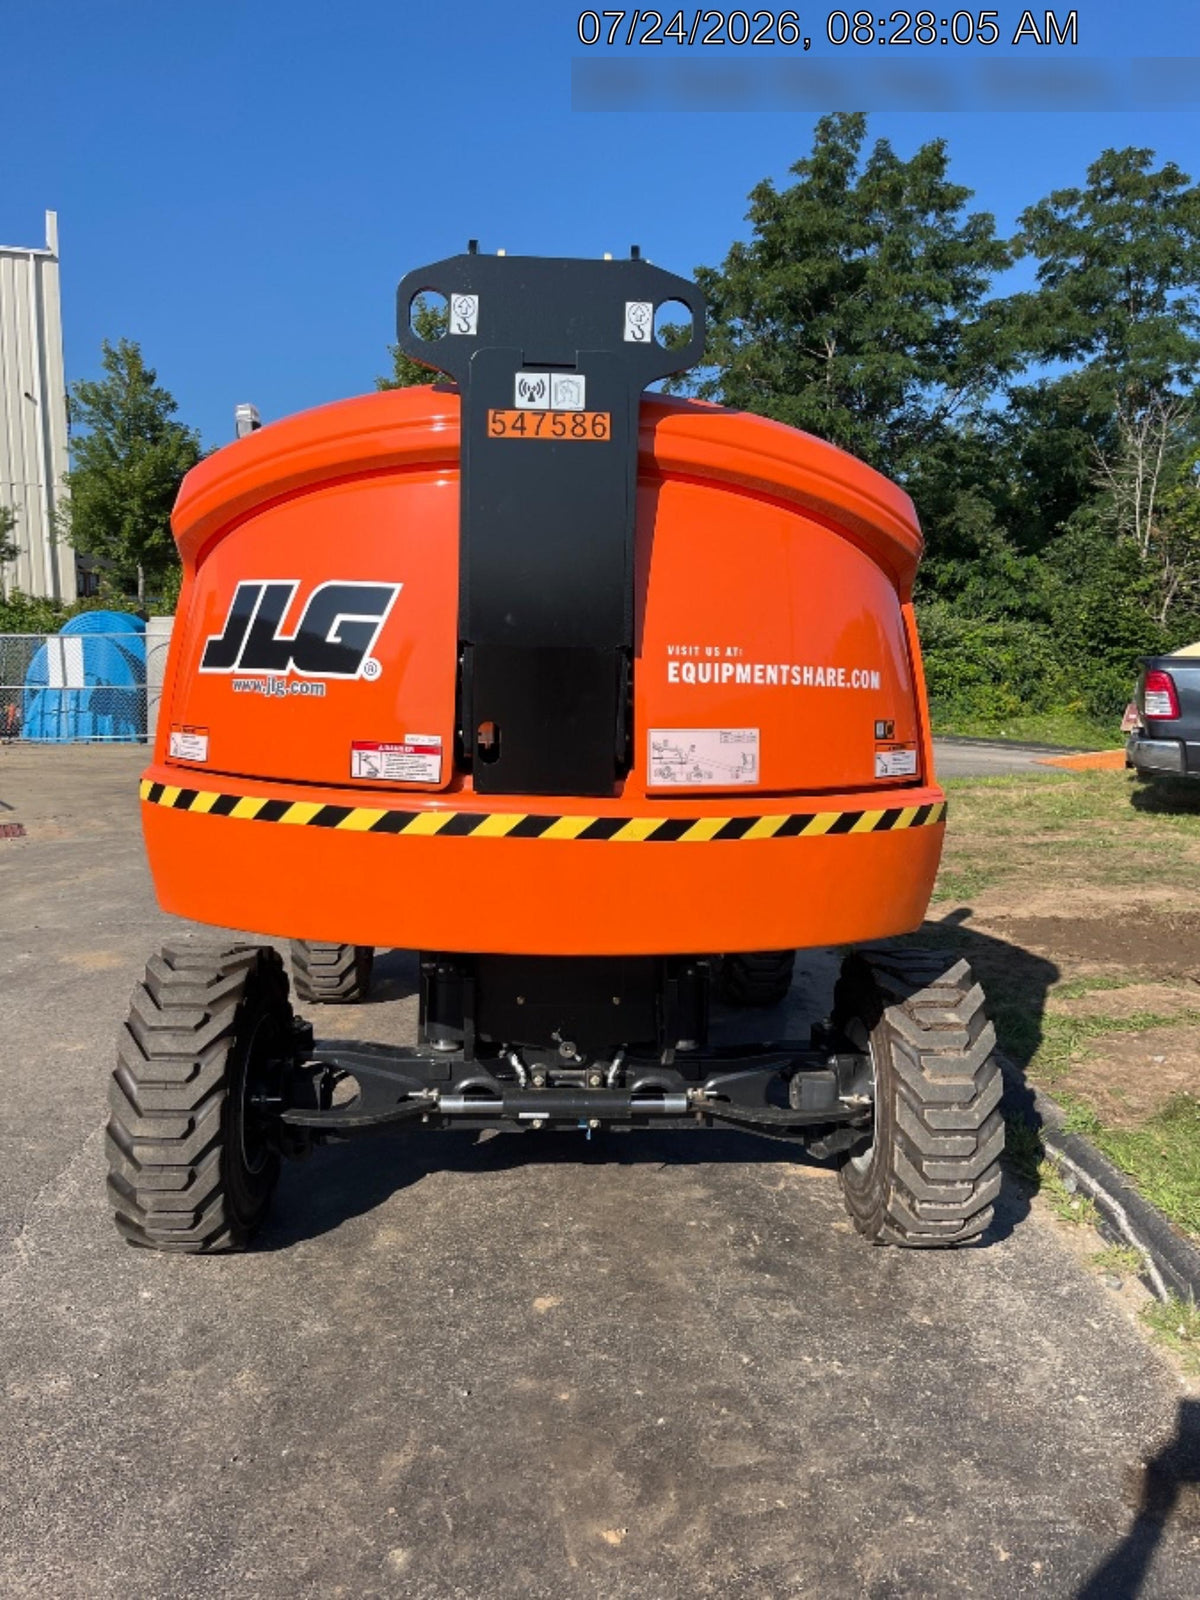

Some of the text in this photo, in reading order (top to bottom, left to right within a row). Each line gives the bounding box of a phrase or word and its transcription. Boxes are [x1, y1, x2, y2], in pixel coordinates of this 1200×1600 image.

[491, 411, 607, 438] 547586
[667, 645, 743, 657] VISIT US AT:
[232, 676, 326, 698] www.jlg.com
[667, 661, 881, 690] EQUIPMENTSHARE.COM
